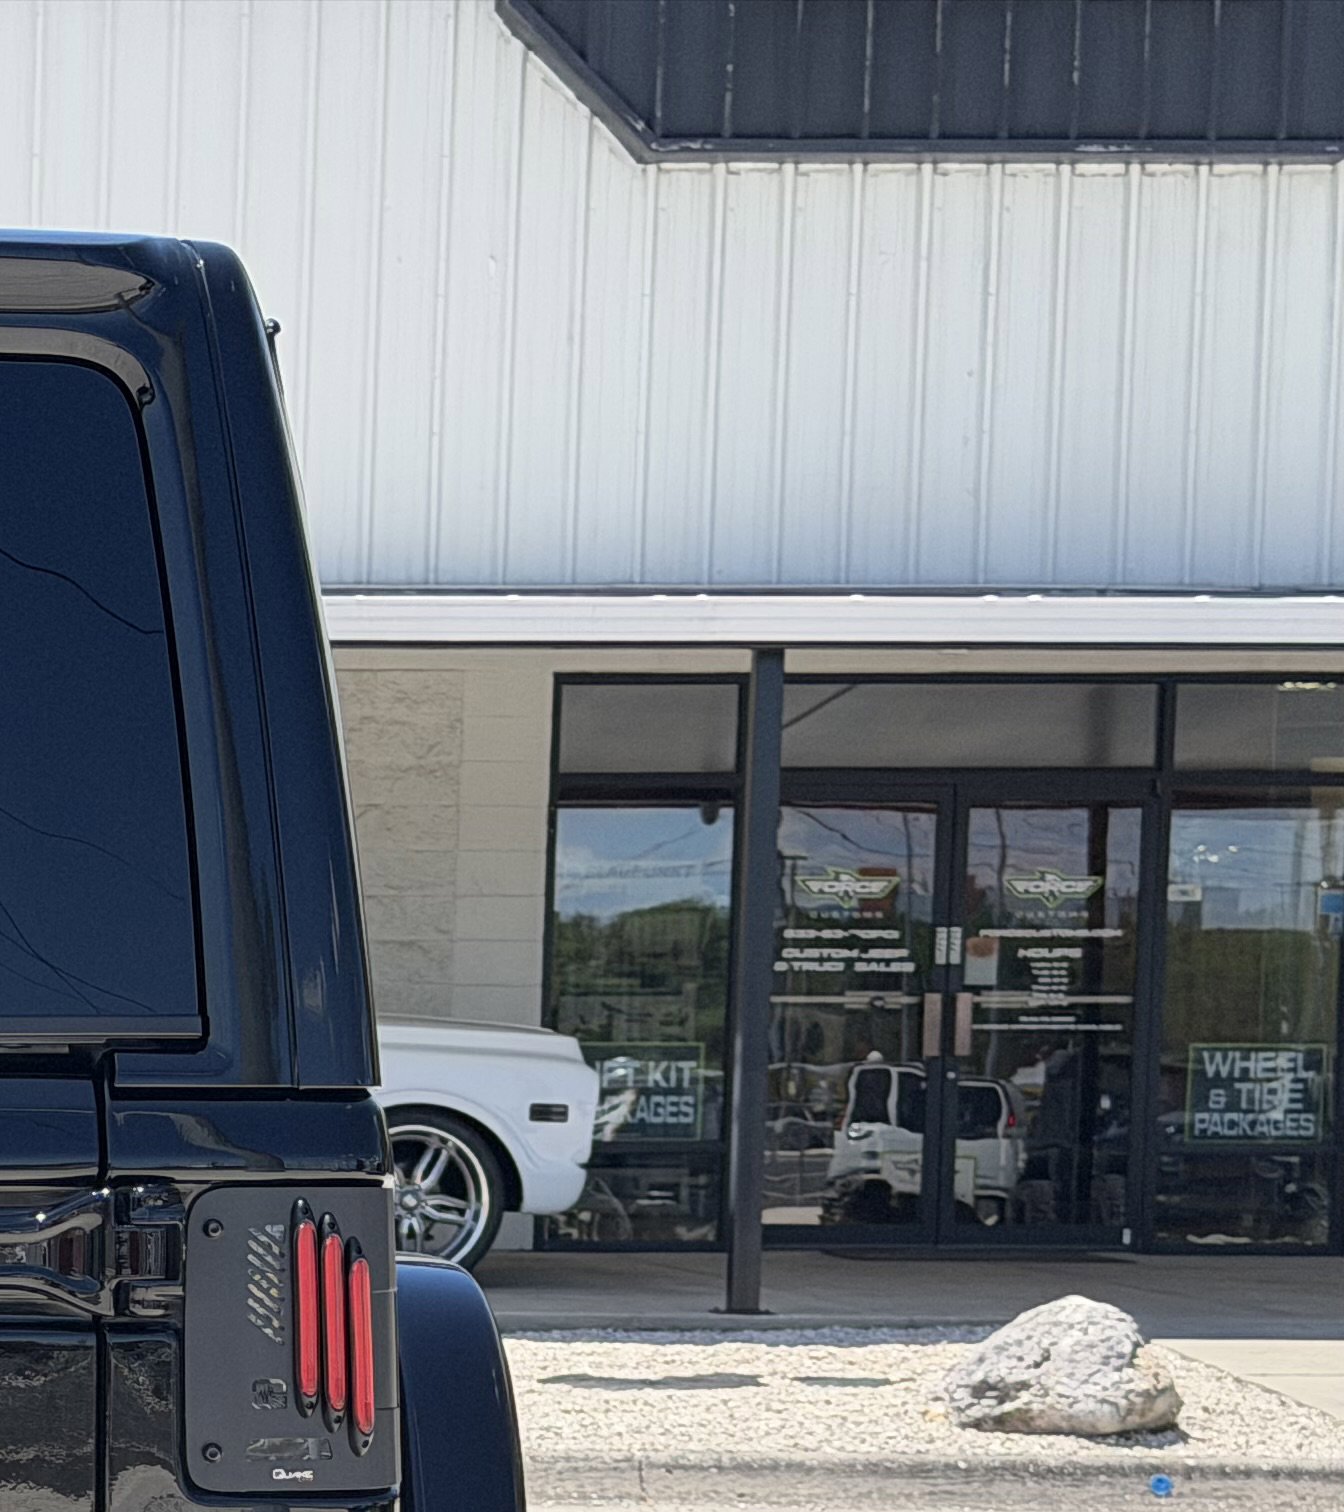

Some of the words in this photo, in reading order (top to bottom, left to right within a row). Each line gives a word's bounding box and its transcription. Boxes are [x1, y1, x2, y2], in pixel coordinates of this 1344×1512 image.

[648, 1060, 697, 1088] KIT
[1202, 1050, 1316, 1078] WHEEL
[1234, 1082, 1304, 1111] TIRE
[1193, 1112, 1316, 1137] PACKAGES
